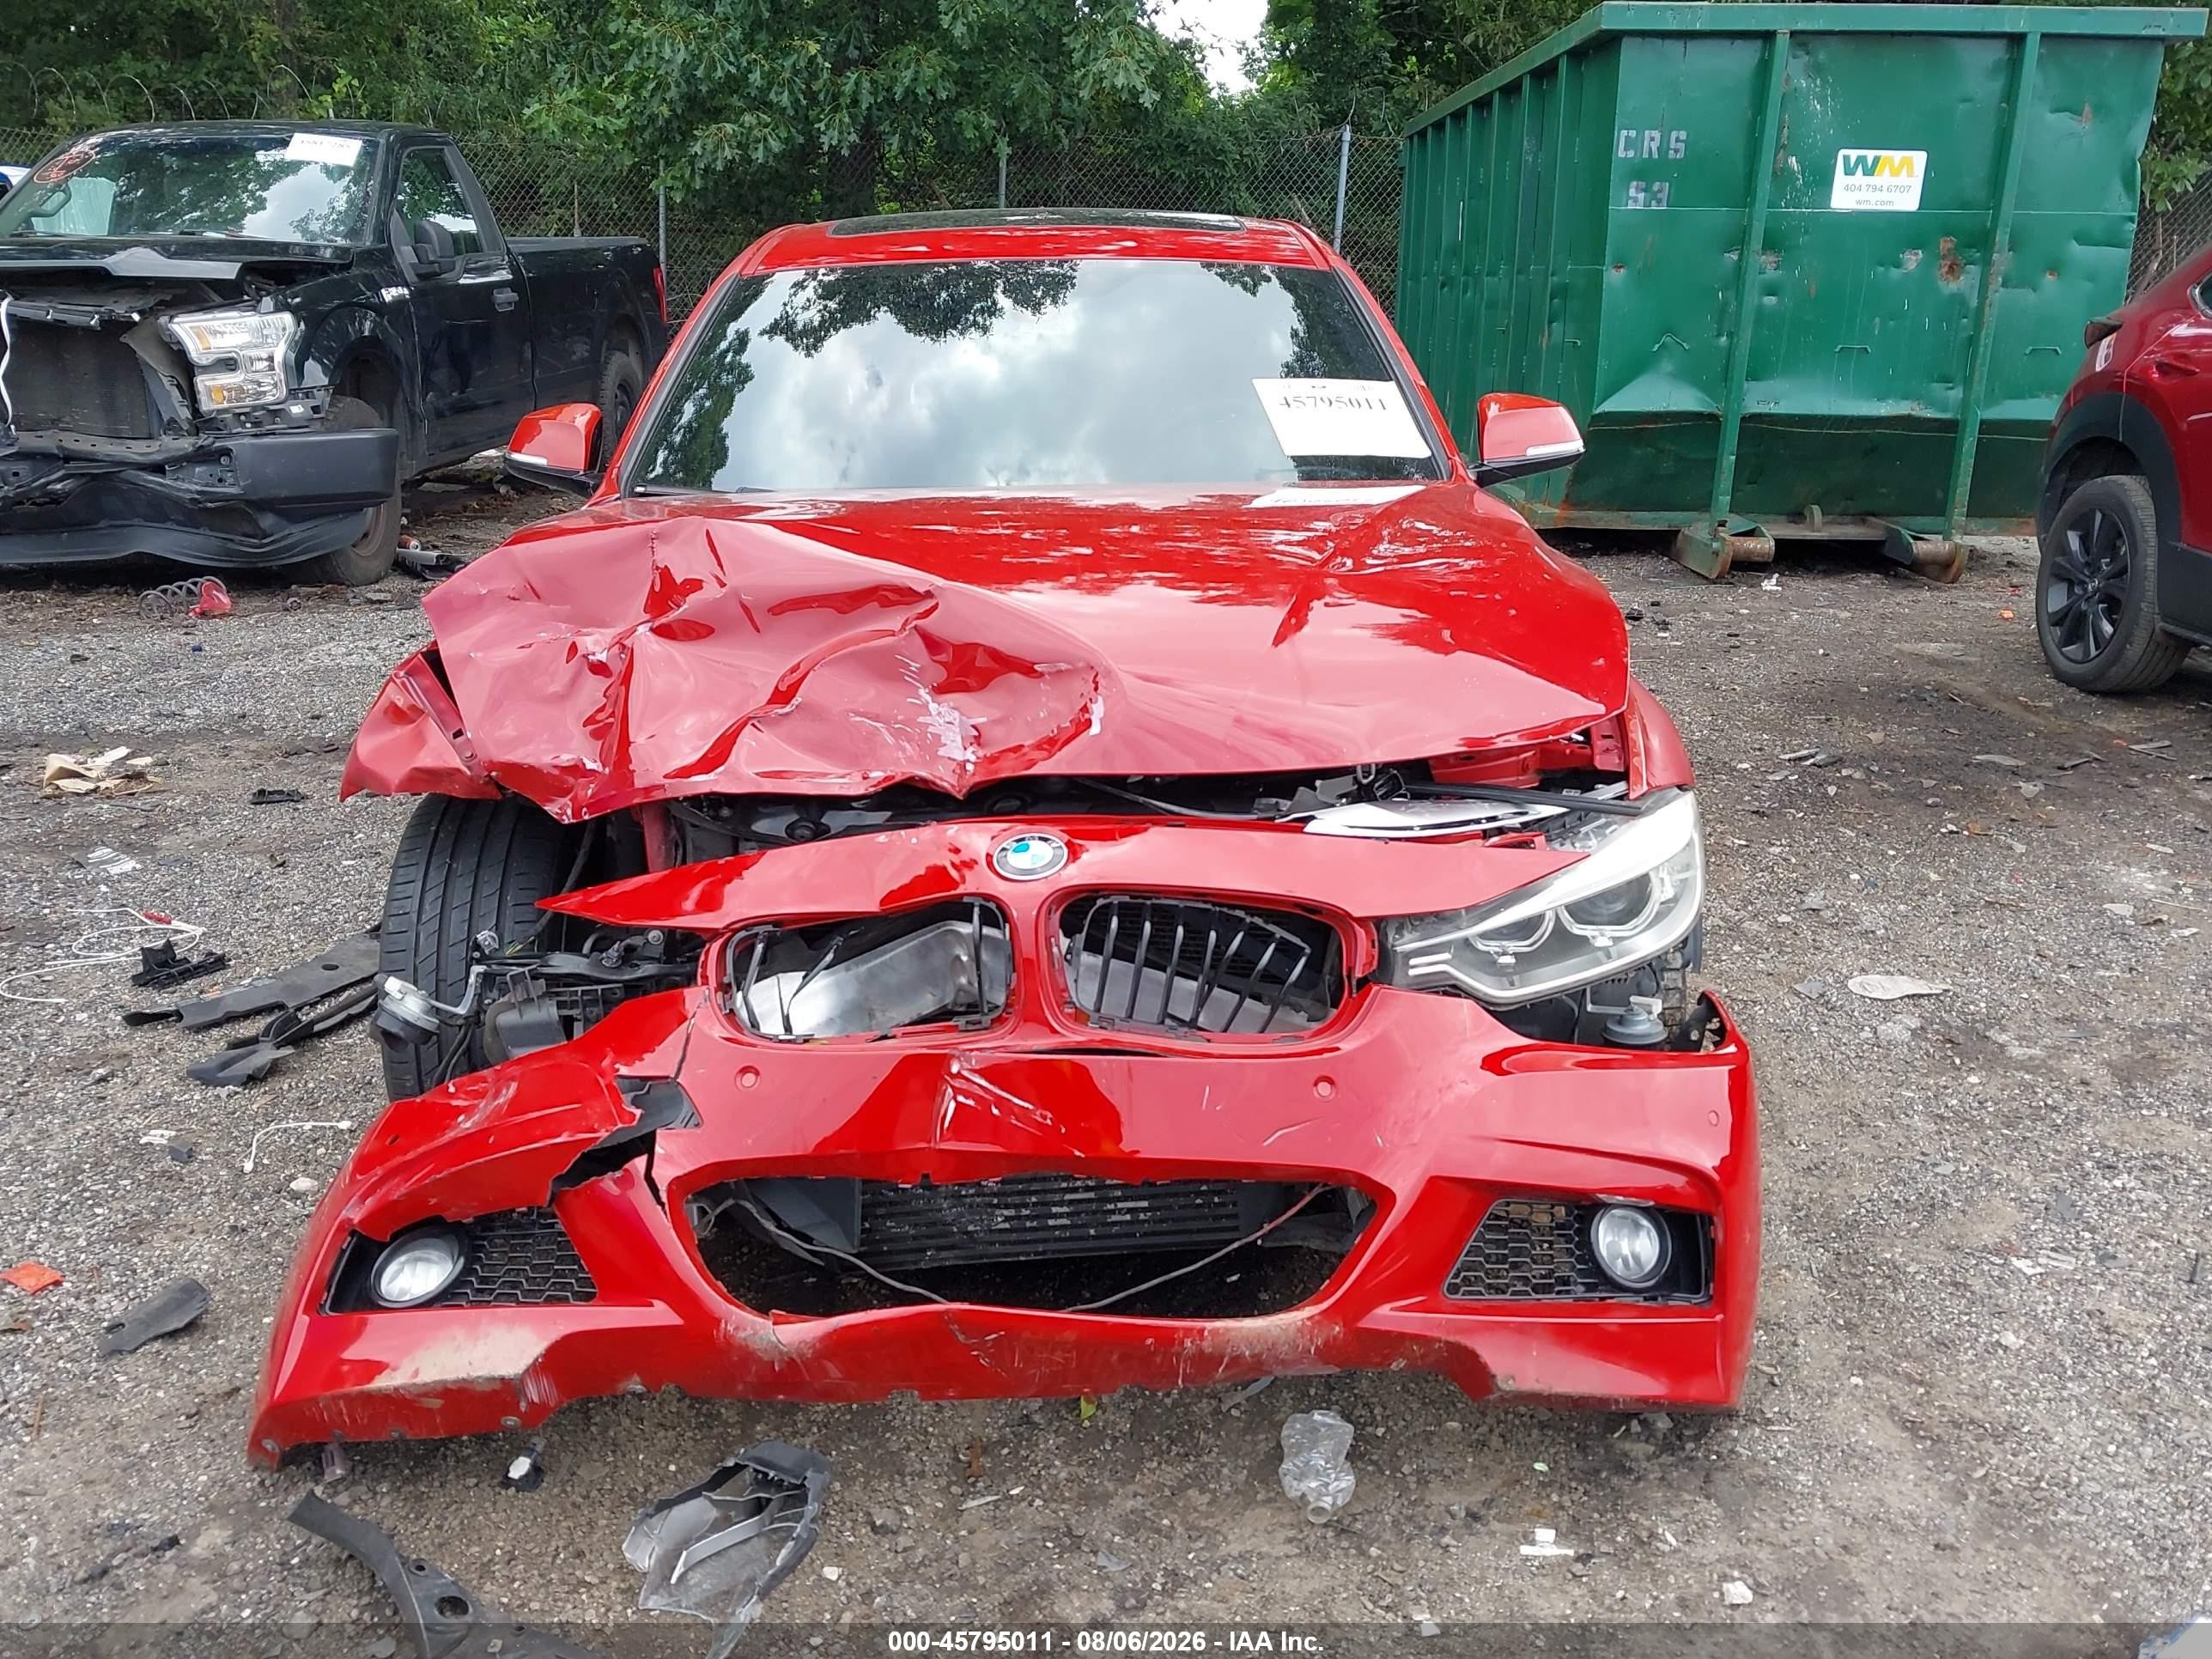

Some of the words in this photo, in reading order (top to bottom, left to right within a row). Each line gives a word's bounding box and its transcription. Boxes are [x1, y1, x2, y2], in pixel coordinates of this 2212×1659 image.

[1618, 130, 1686, 158] CRS
[1843, 155, 1915, 177] WM
[1844, 184, 1863, 192] 404
[1865, 184, 1884, 193] 794
[1887, 185, 1912, 193] 6707
[1855, 198, 1894, 207] wm.com
[1279, 396, 1387, 410] 45795011
